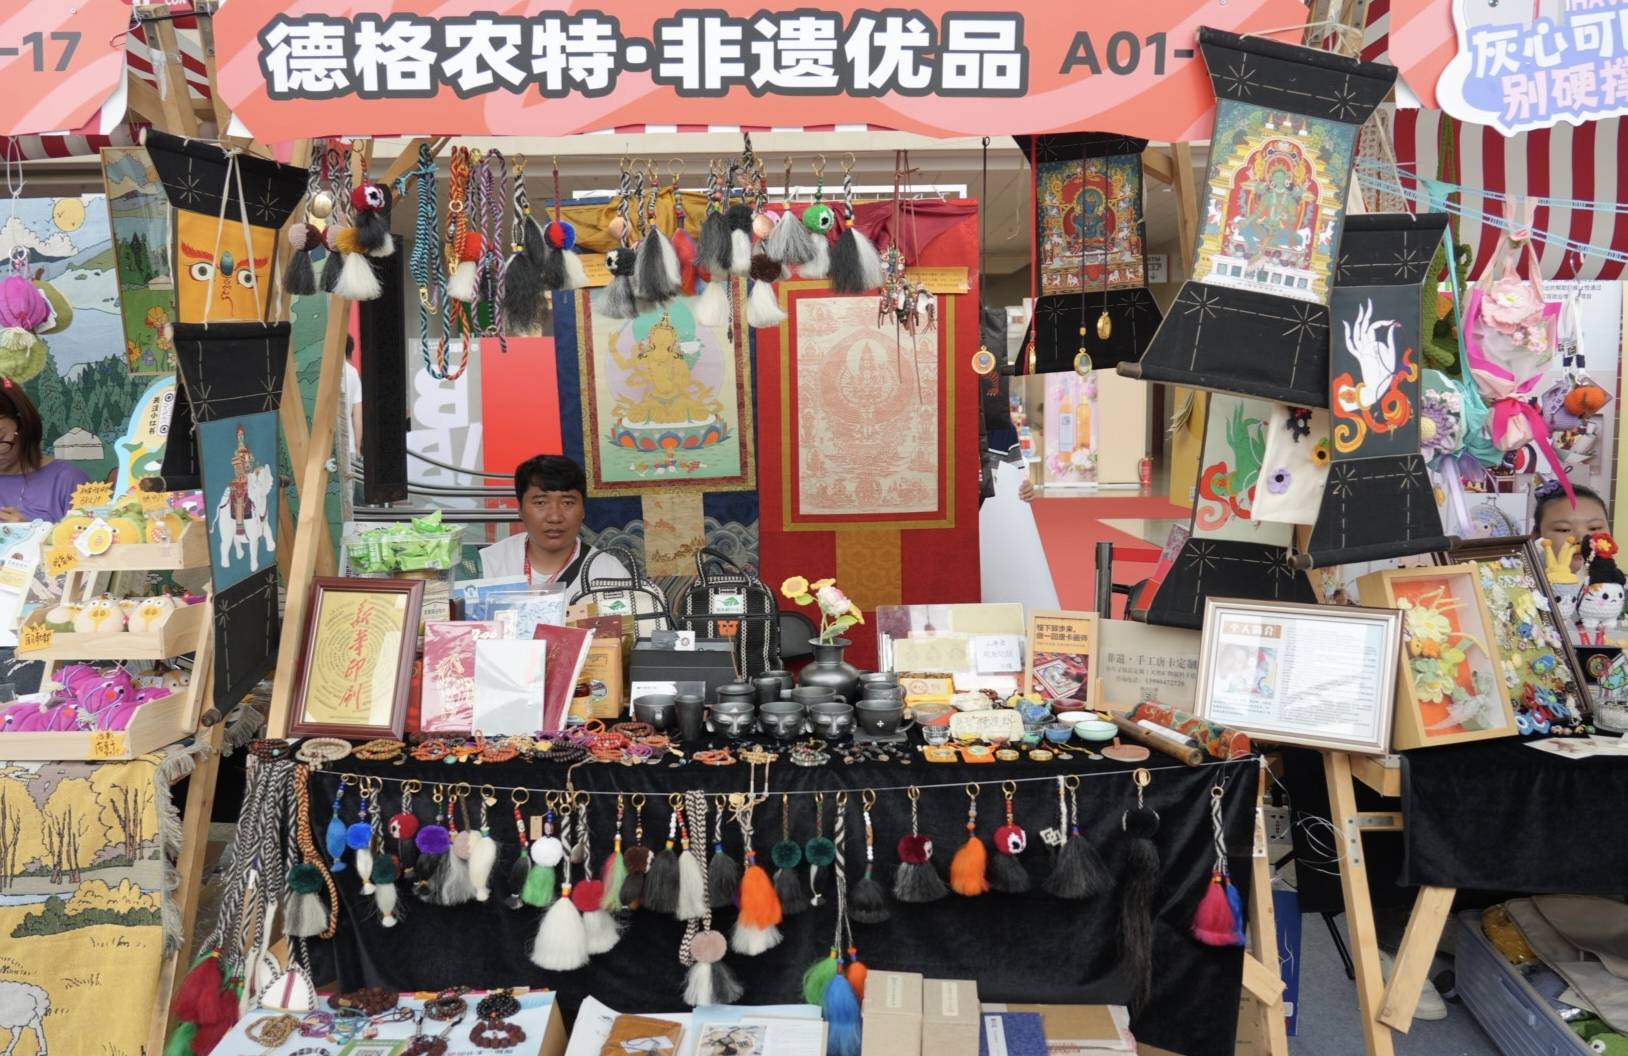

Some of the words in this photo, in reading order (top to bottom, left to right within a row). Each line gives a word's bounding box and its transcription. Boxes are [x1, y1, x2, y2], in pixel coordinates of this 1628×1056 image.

[262, 12, 1025, 96] 德格农特·非遗优品
[1472, 10, 1628, 78] 灰心可
[1228, 623, 1274, 637] 个人简介
